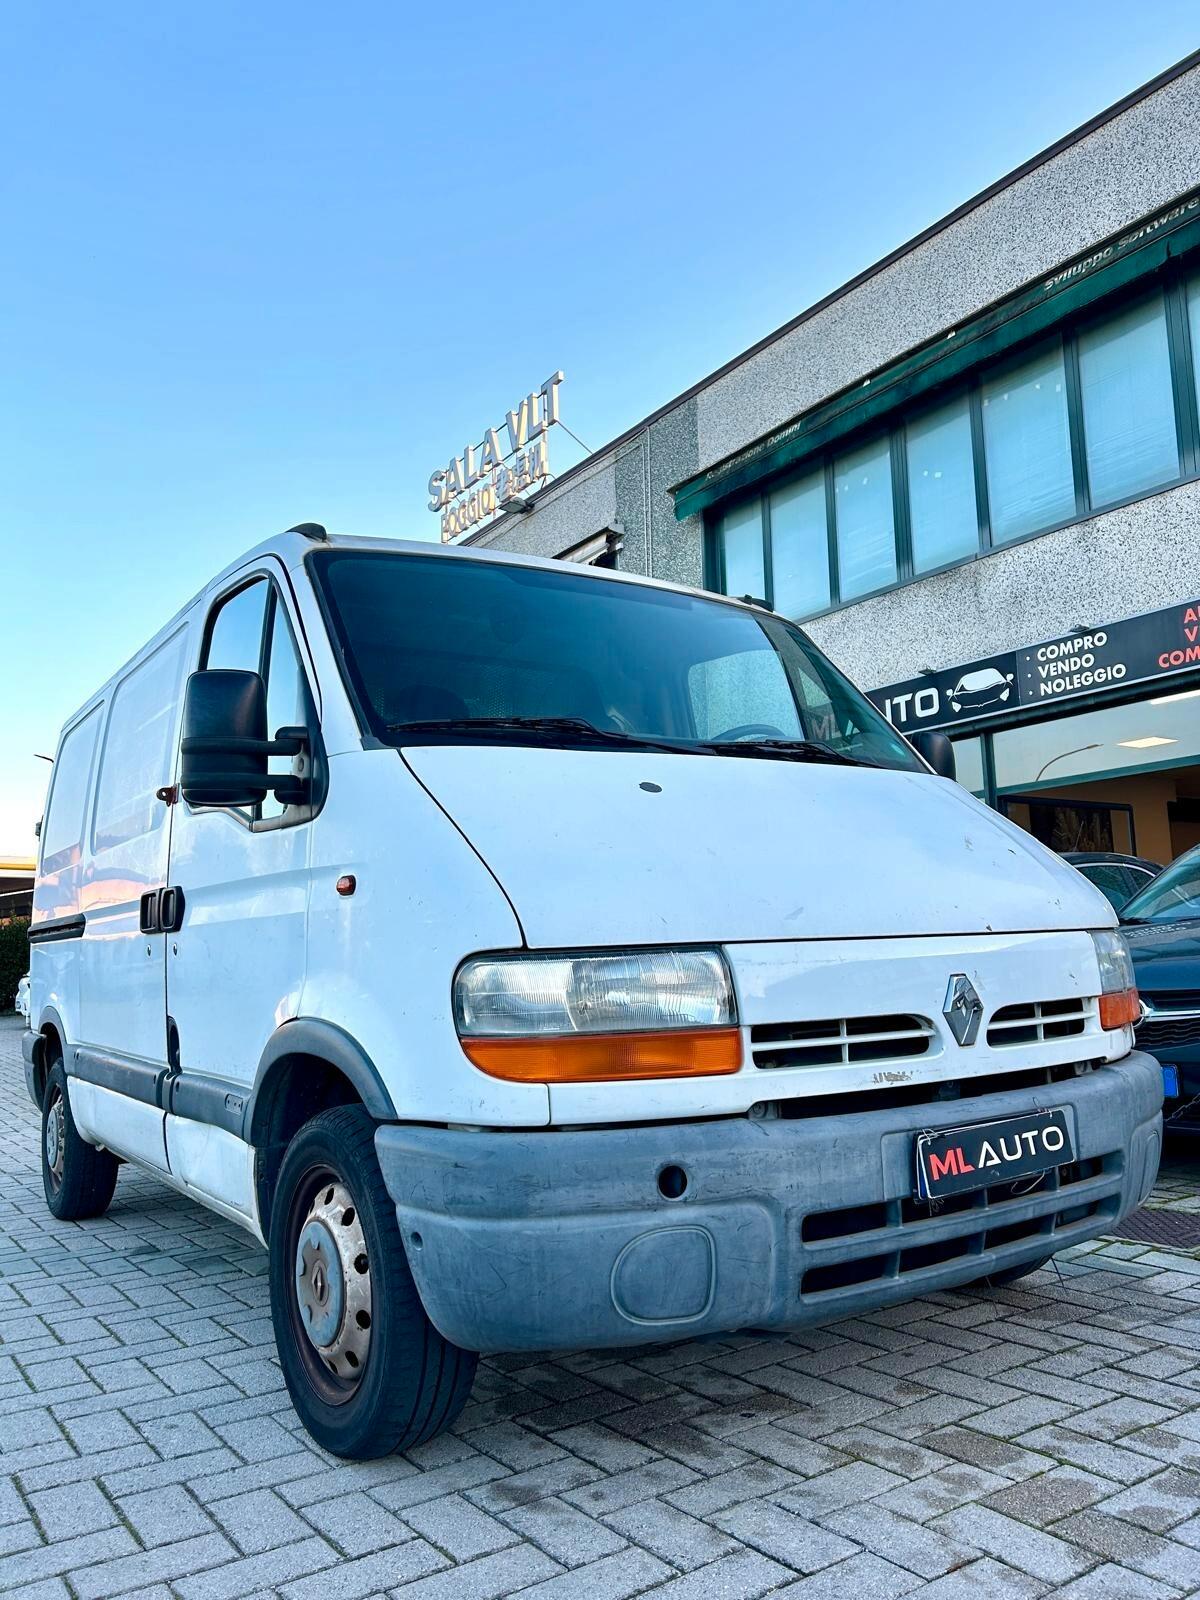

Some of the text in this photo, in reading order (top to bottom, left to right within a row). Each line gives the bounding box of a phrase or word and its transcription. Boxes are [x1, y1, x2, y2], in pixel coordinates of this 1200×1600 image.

[428, 371, 564, 513] SALA VLT
[1037, 631, 1108, 662] COMPRO
[1038, 653, 1095, 679] VENDO
[1040, 663, 1127, 697] NOLEGGIO
